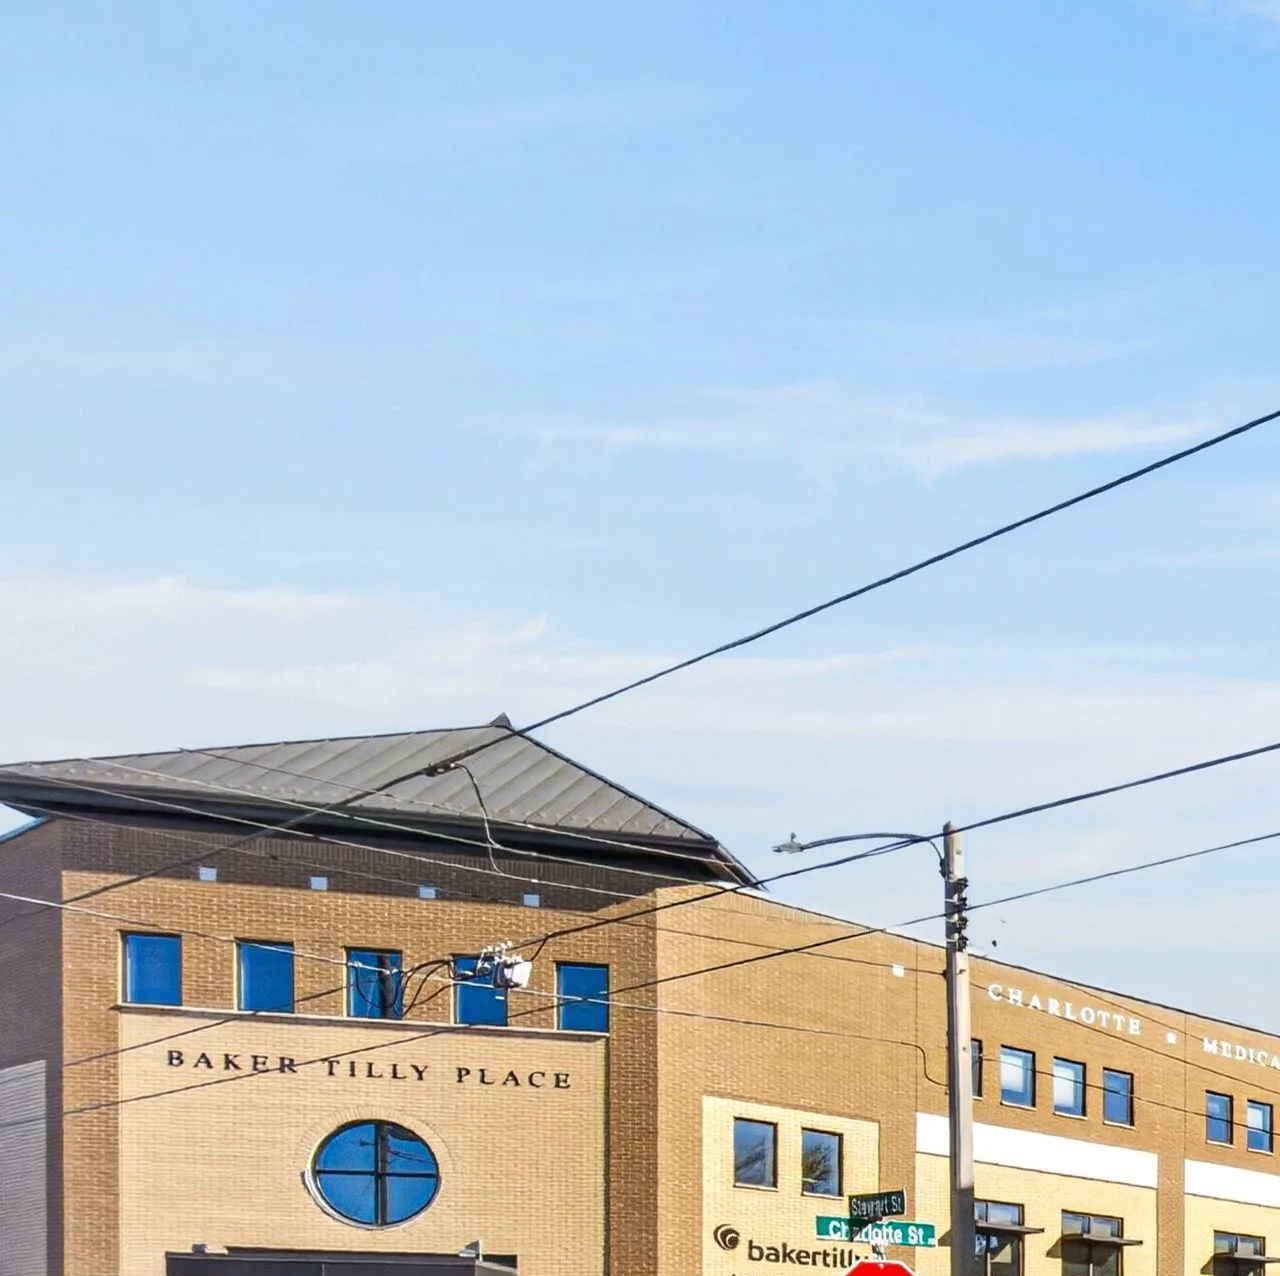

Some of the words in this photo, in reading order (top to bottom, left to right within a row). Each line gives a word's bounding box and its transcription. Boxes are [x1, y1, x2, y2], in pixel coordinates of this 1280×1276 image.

[988, 983, 1140, 1036] CHARLOTTE
[167, 1050, 299, 1073] BAKER
[322, 1058, 429, 1081] TILLY
[456, 1068, 572, 1089] PLACE
[851, 1196, 888, 1216] Stewart
[891, 1195, 902, 1212] St
[828, 1220, 902, 1244] Charlotte
[908, 1225, 925, 1245] St
